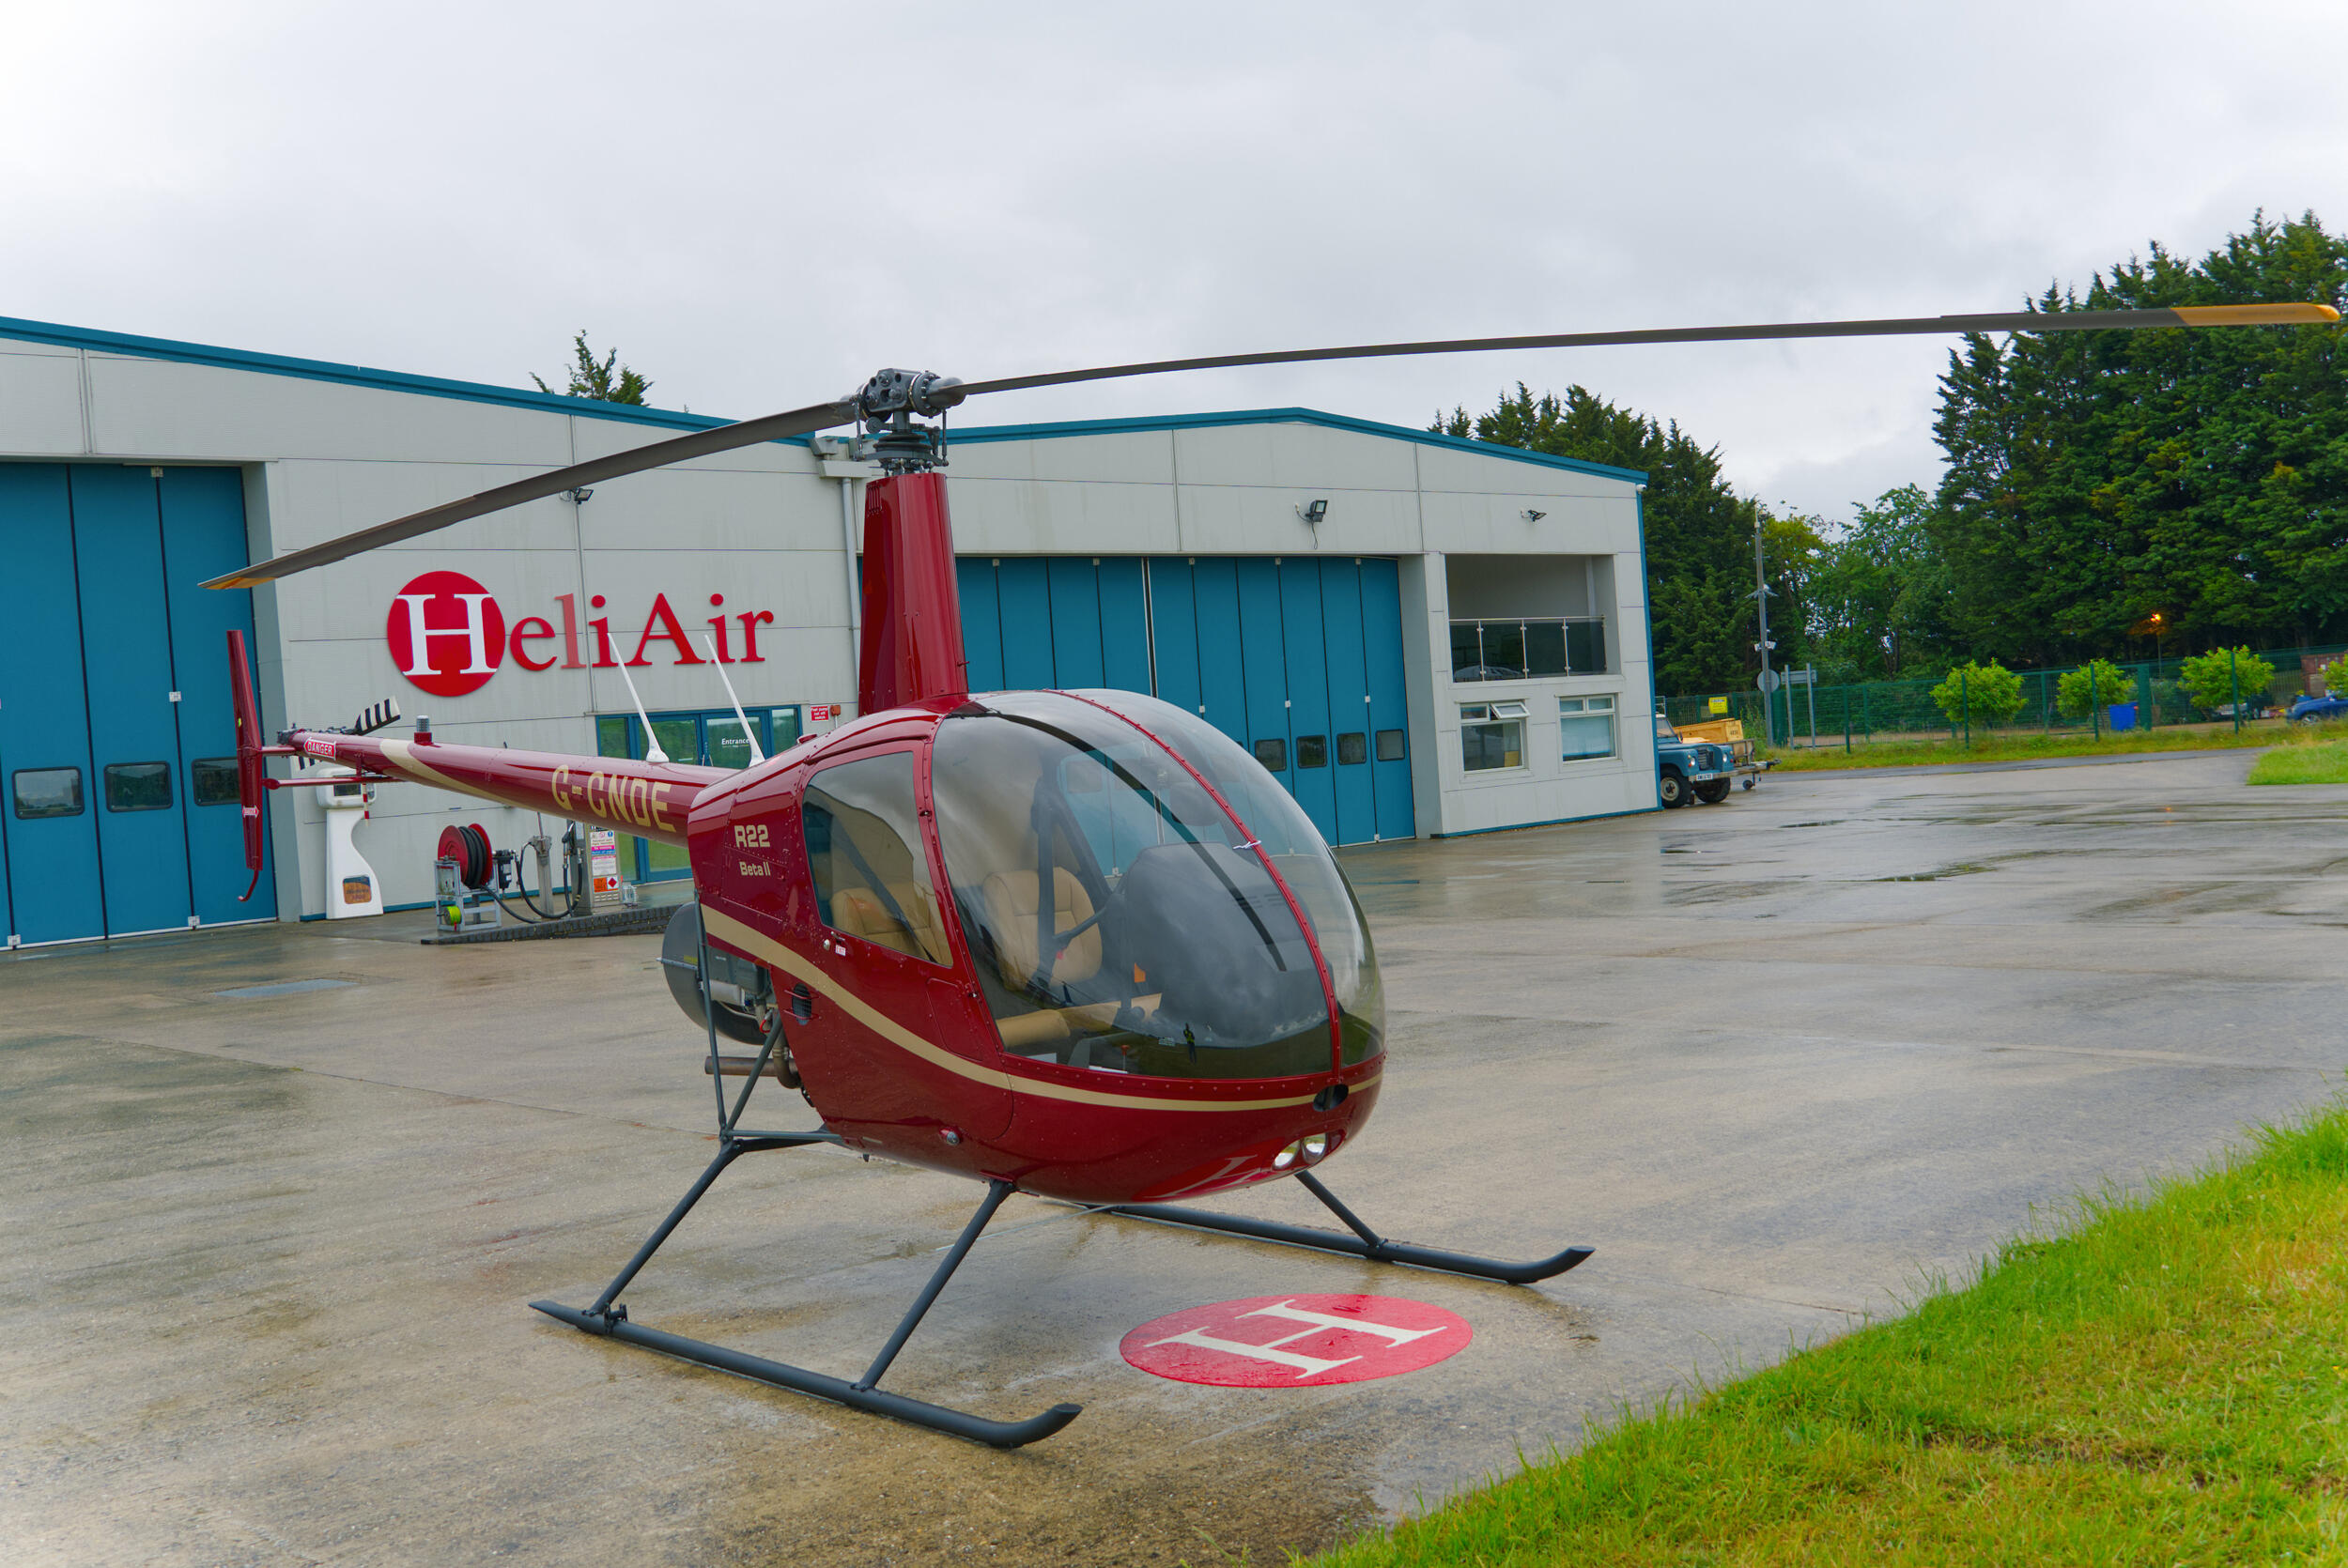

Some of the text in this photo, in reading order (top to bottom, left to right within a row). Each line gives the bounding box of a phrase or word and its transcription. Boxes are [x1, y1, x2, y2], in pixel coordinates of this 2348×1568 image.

[395, 592, 776, 674] HeliAir
[307, 742, 332, 756] DANGER
[551, 764, 676, 833] G-CNDE
[734, 824, 771, 848] R22
[739, 861, 764, 876] Beta
[1144, 1299, 1448, 1379] H
